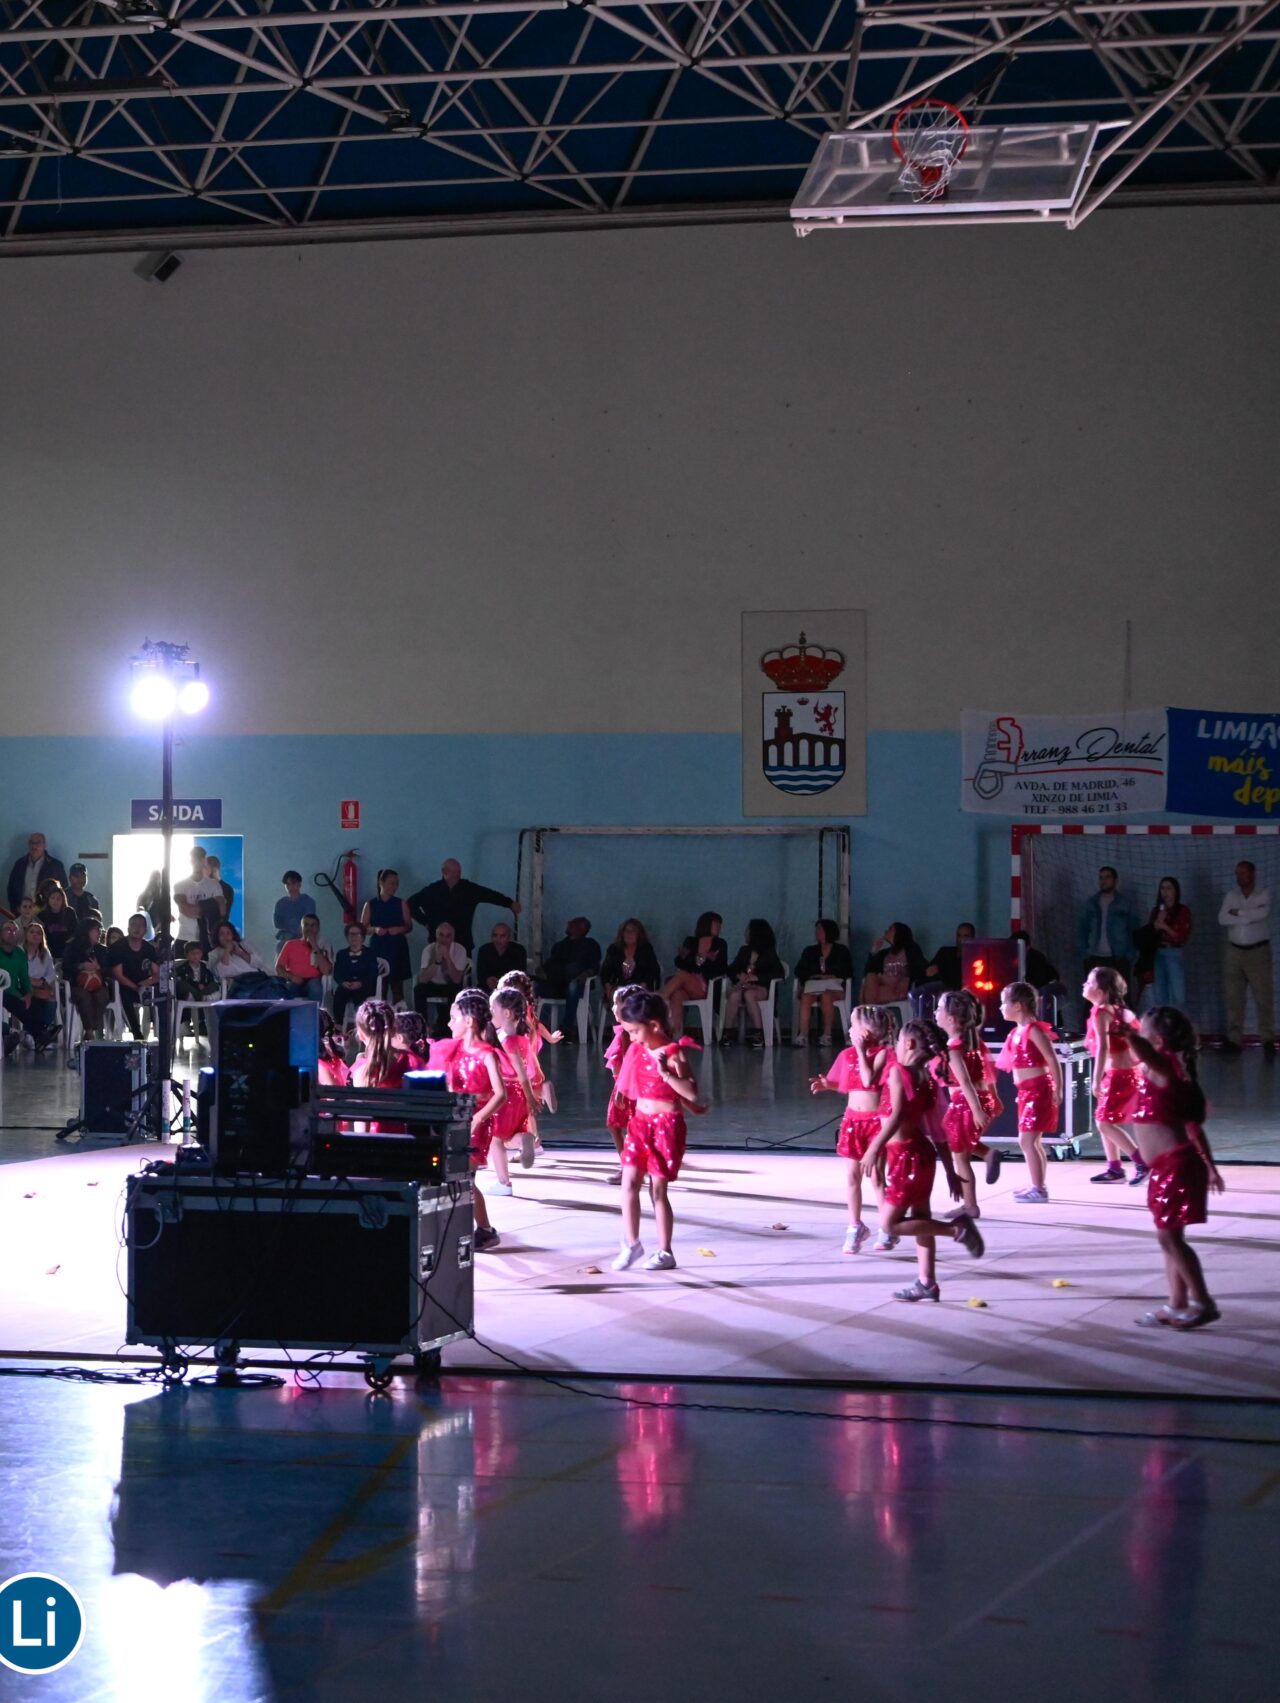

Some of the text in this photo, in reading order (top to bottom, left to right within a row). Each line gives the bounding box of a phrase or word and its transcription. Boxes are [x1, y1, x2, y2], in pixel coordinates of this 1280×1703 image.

[1076, 727, 1166, 763] Dental
[1196, 718, 1280, 750] LIMIA
[1207, 748, 1273, 782] máis
[1014, 780, 1051, 792] AVDA.
[1053, 780, 1069, 791] DE
[1122, 777, 1136, 788] 46
[1023, 805, 1048, 814] TELF
[1058, 805, 1079, 815] 988
[1081, 804, 1095, 814] 46
[1097, 803, 1111, 813] 21
[1114, 802, 1128, 812] 33
[1031, 791, 1119, 803] XINZO DE LIMIA
